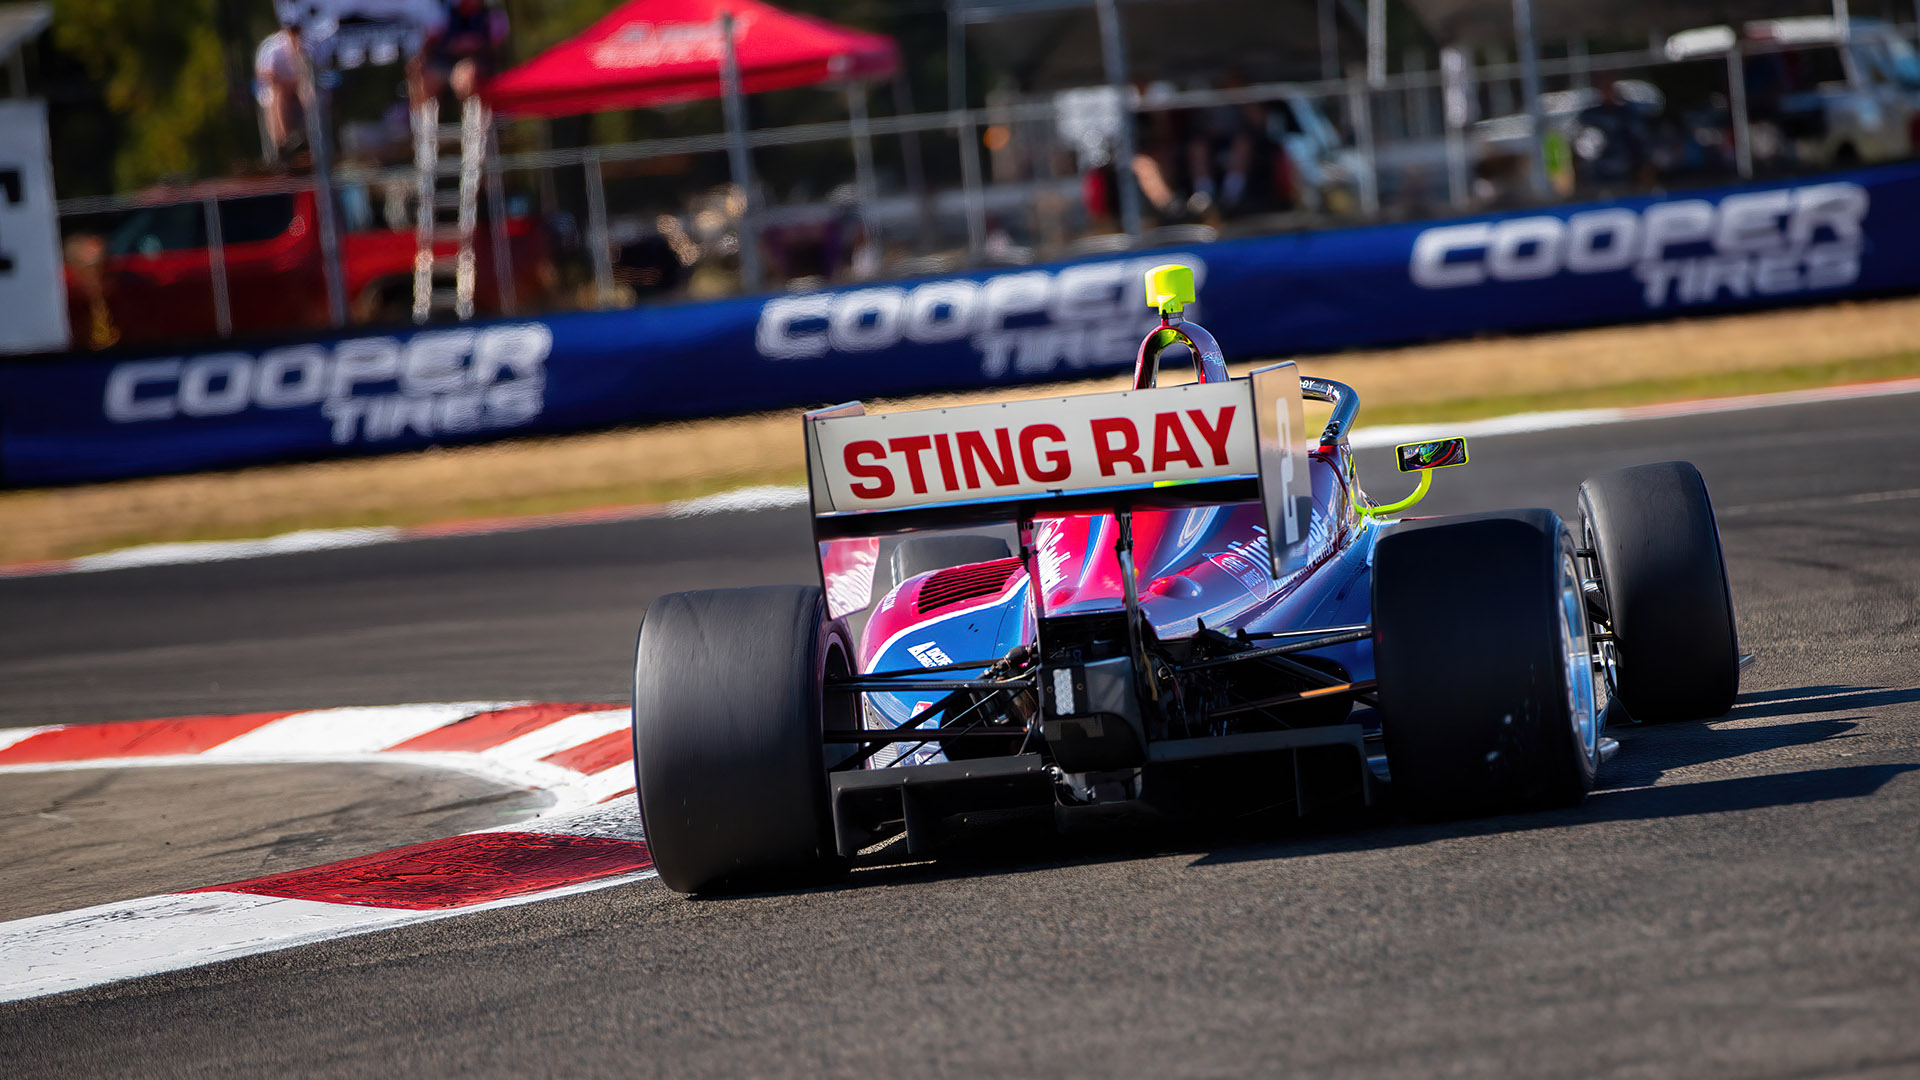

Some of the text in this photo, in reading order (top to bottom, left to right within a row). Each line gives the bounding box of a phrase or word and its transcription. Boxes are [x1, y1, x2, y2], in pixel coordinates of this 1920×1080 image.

[1410, 182, 1869, 289] COOPER
[1635, 245, 1860, 307] TIRES
[104, 322, 553, 423] COOPER
[321, 380, 547, 445] TIRES
[843, 406, 1236, 499] STING RAY
